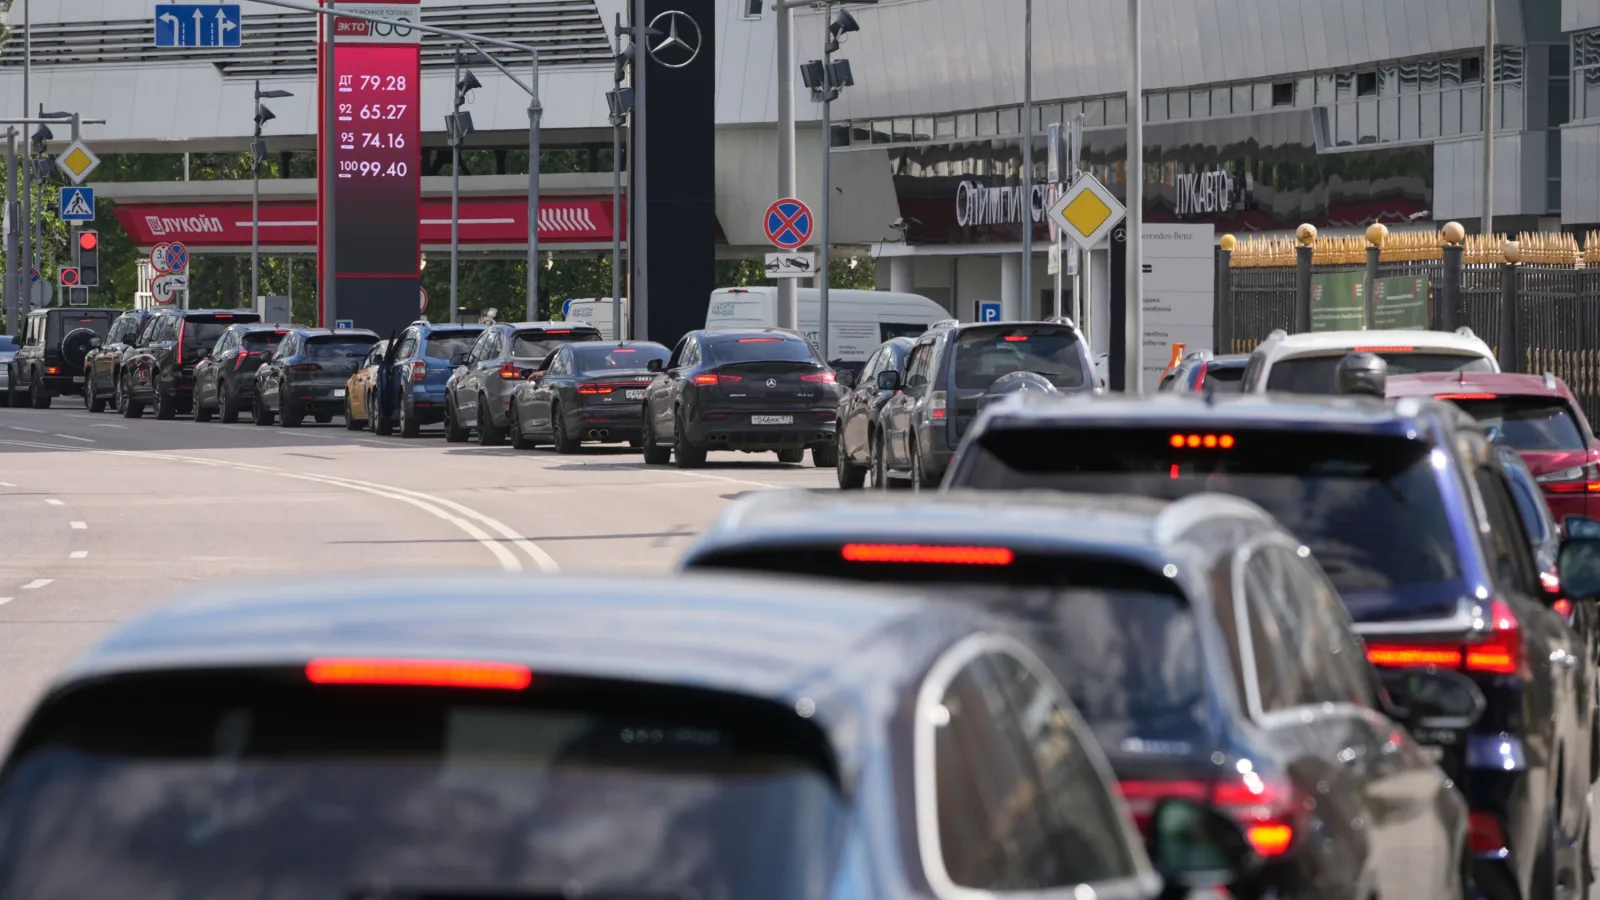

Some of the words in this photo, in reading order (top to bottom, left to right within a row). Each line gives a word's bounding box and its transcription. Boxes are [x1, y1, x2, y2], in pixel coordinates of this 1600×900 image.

[337, 22, 366, 31] ЭКТО
[339, 74, 353, 86] ДТ
[360, 75, 406, 91] 79.28
[339, 103, 352, 114] 92
[360, 104, 407, 119] 65.27
[341, 132, 354, 142] 95
[361, 132, 405, 148] 74.16
[340, 161, 358, 171] 100
[359, 161, 407, 177] 99.40
[161, 214, 223, 232] ЛУКОЙЛ
[1141, 231, 1193, 240] ercedes-Benz
[986, 309, 996, 321] P
